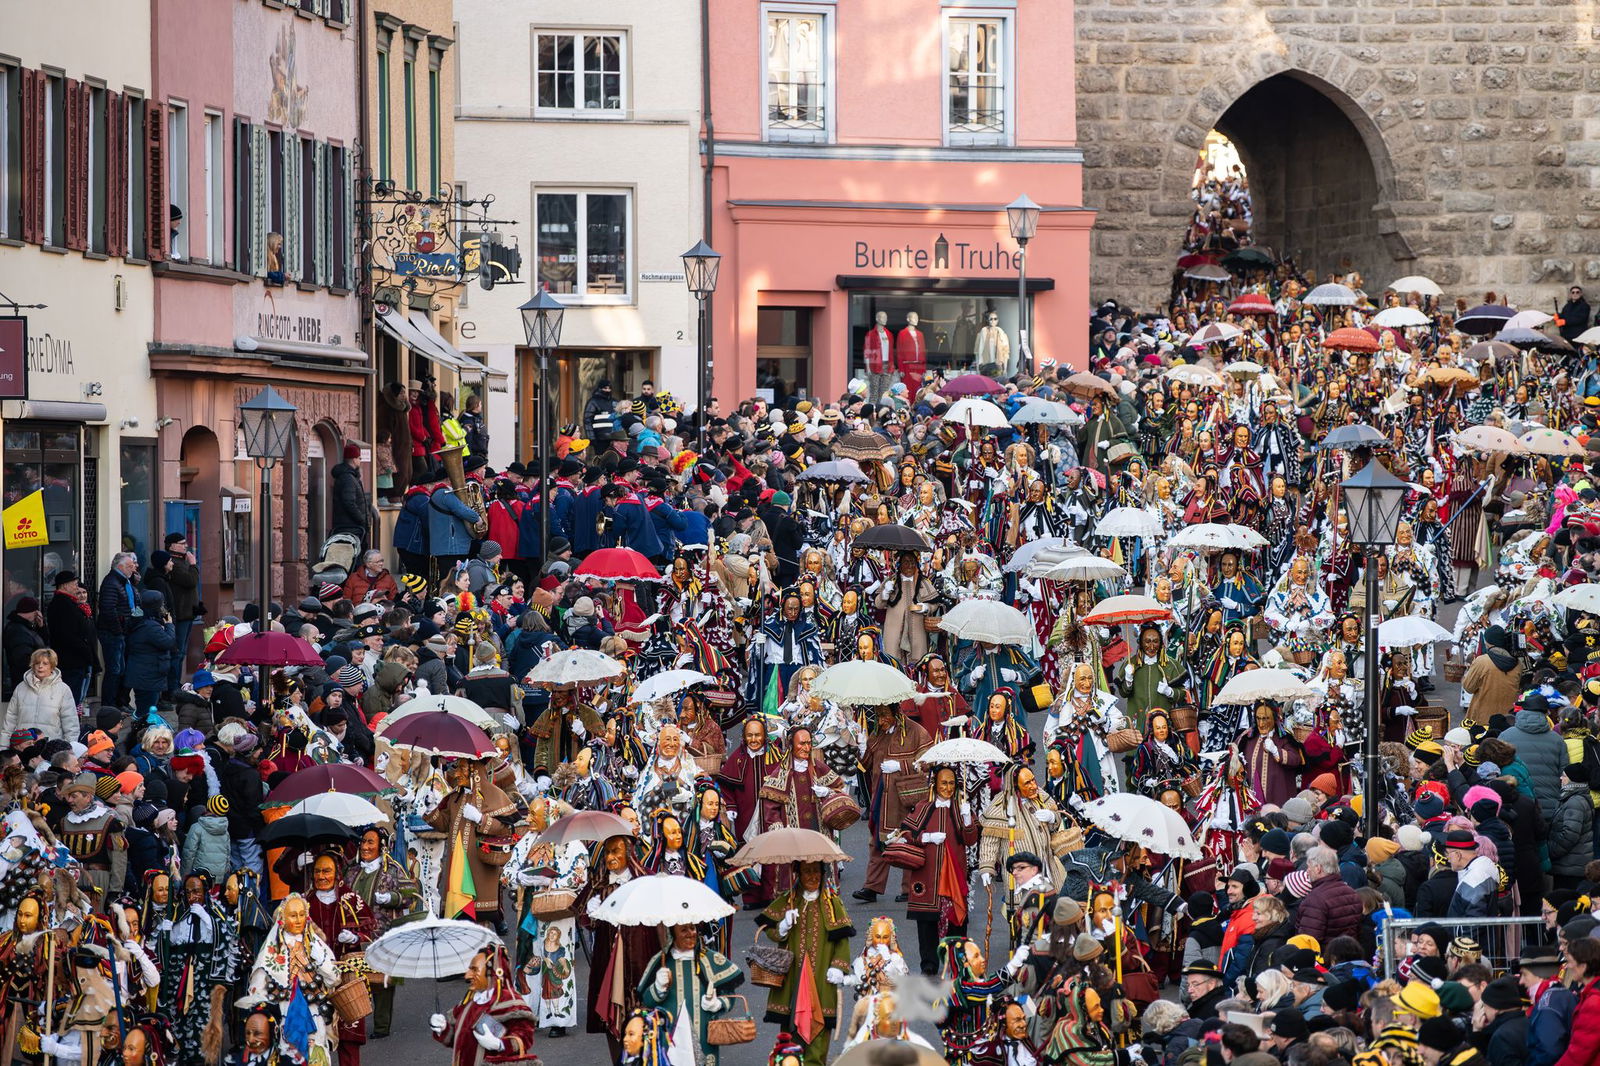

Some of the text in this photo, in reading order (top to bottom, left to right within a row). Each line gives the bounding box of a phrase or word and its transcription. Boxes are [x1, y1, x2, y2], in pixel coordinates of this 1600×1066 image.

[855, 241, 1023, 270] Bunte Truhe
[405, 258, 456, 275] Riede
[298, 317, 321, 343] RIEDE
[461, 321, 476, 339] e
[676, 330, 684, 340] 2
[14, 531, 38, 540] LOTTO
